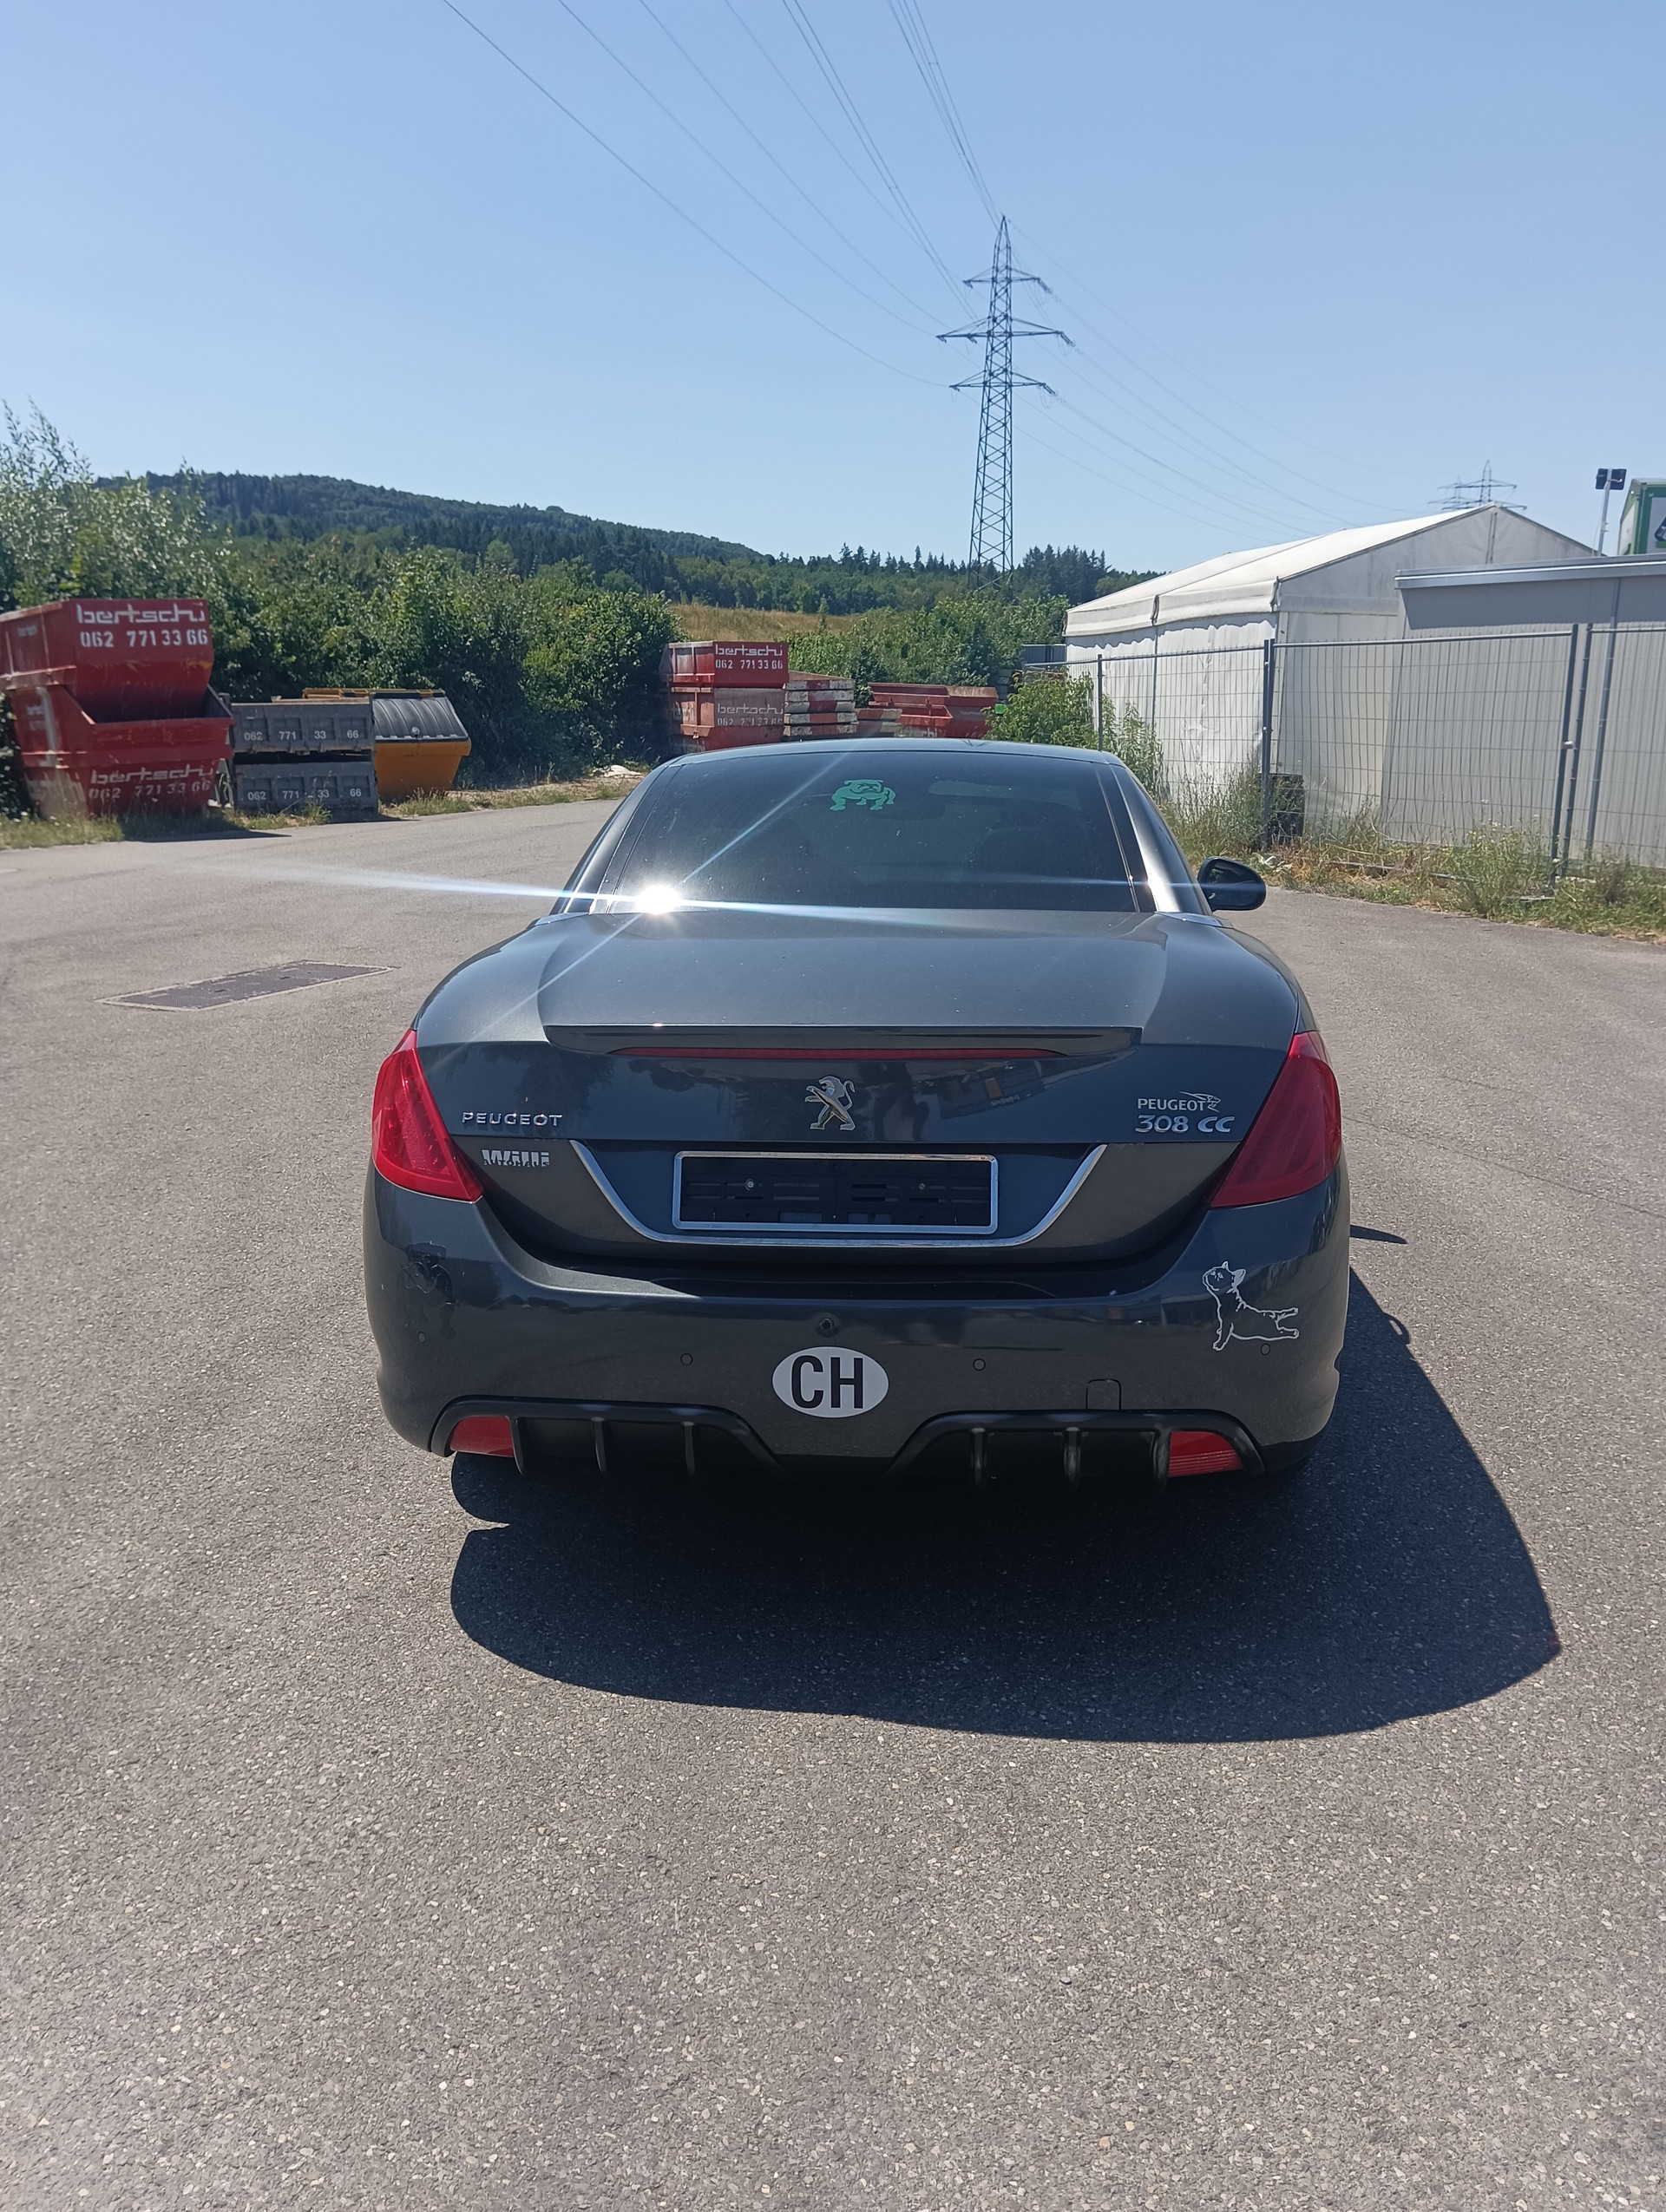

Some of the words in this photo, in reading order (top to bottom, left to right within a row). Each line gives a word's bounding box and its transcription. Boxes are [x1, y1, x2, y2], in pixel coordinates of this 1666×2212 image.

[76, 603, 206, 624] bertschi
[80, 631, 115, 648] 062
[127, 630, 157, 647] 771
[161, 629, 181, 645] 33
[187, 628, 208, 645] 66
[715, 644, 784, 656] bertschi
[715, 659, 733, 669] 062
[740, 659, 756, 670] 771
[758, 659, 769, 670] 33
[771, 660, 784, 670] 66
[717, 703, 784, 715] bertschi
[244, 731, 263, 742] 062
[279, 730, 297, 740] 771
[314, 730, 327, 739] 33
[347, 730, 359, 738] 66
[89, 787, 121, 799] 062
[134, 784, 162, 797] 771
[167, 782, 187, 795] 33
[191, 781, 211, 793] 66
[247, 791, 267, 801] 062
[282, 790, 299, 799] 771
[317, 789, 330, 798] 33
[350, 788, 362, 796] 66
[1138, 1098, 1206, 1111] PEUGEOT
[462, 1112, 563, 1126] PEUGEOT
[1134, 1115, 1189, 1133] 308
[1197, 1116, 1236, 1133] CC
[791, 1355, 864, 1409] CH
